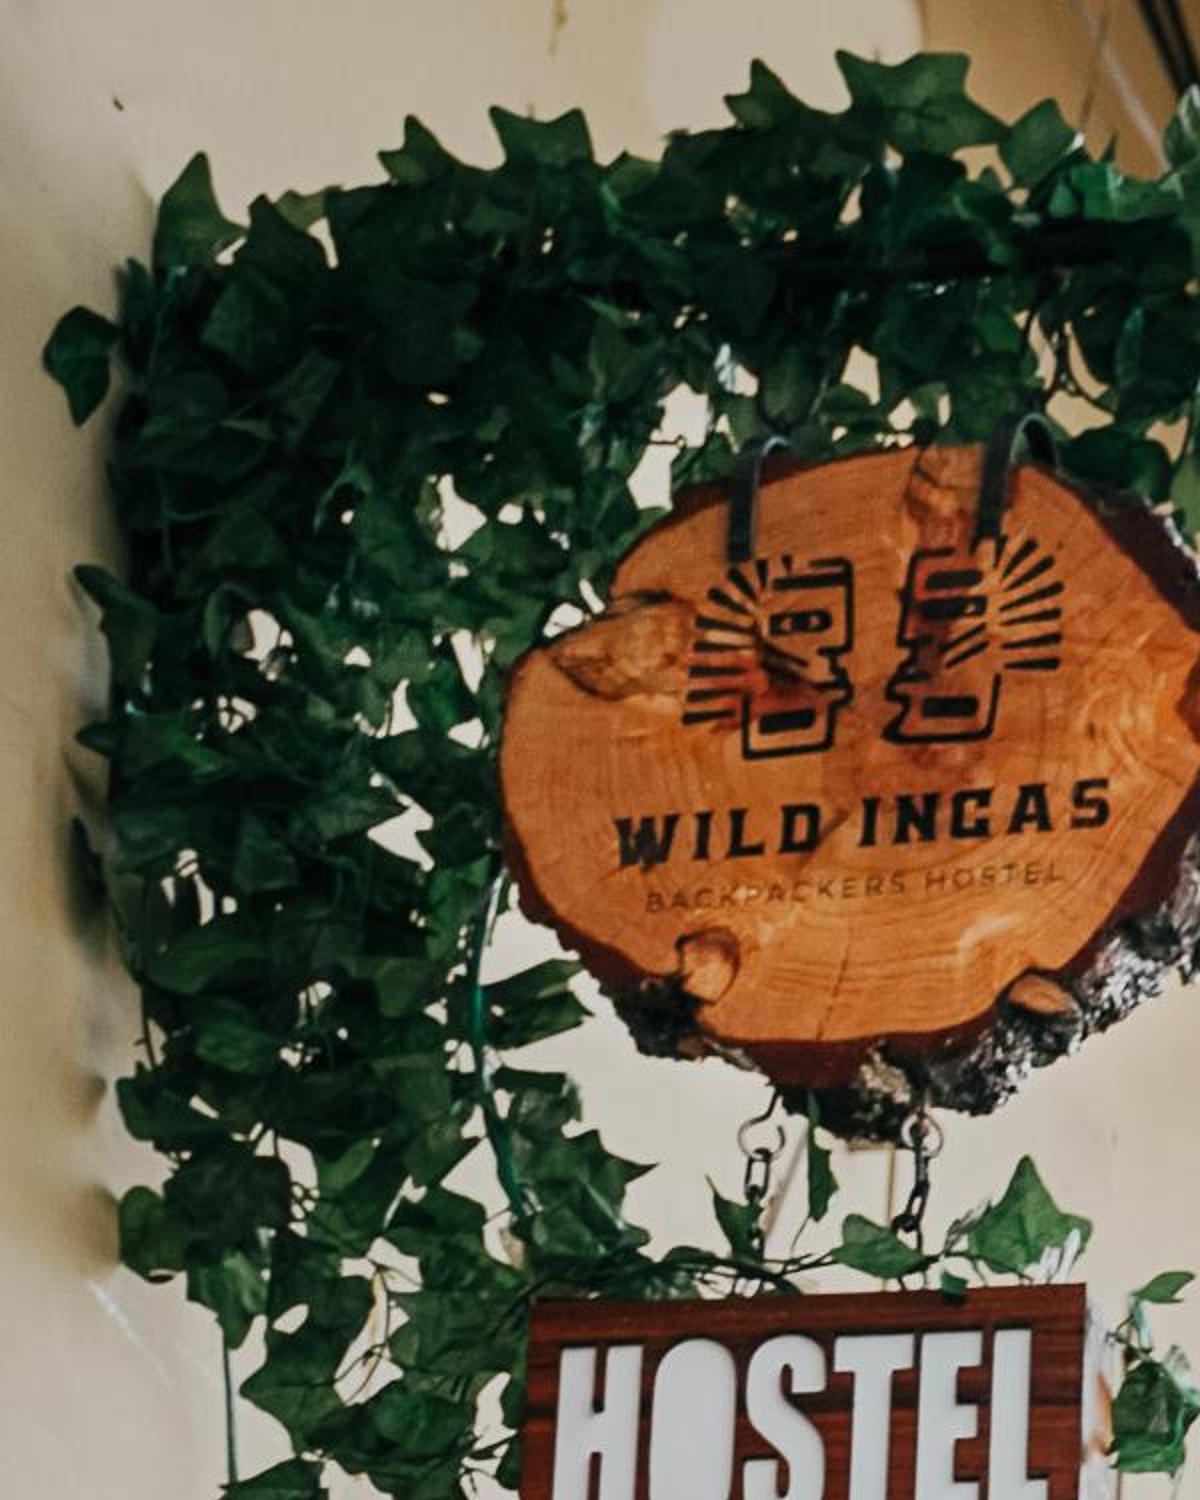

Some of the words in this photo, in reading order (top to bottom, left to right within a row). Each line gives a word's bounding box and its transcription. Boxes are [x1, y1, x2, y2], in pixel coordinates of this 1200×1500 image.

[613, 801, 827, 876] WILD
[645, 873, 907, 914] BACKPACKERS
[924, 861, 1066, 890] HOSTEL
